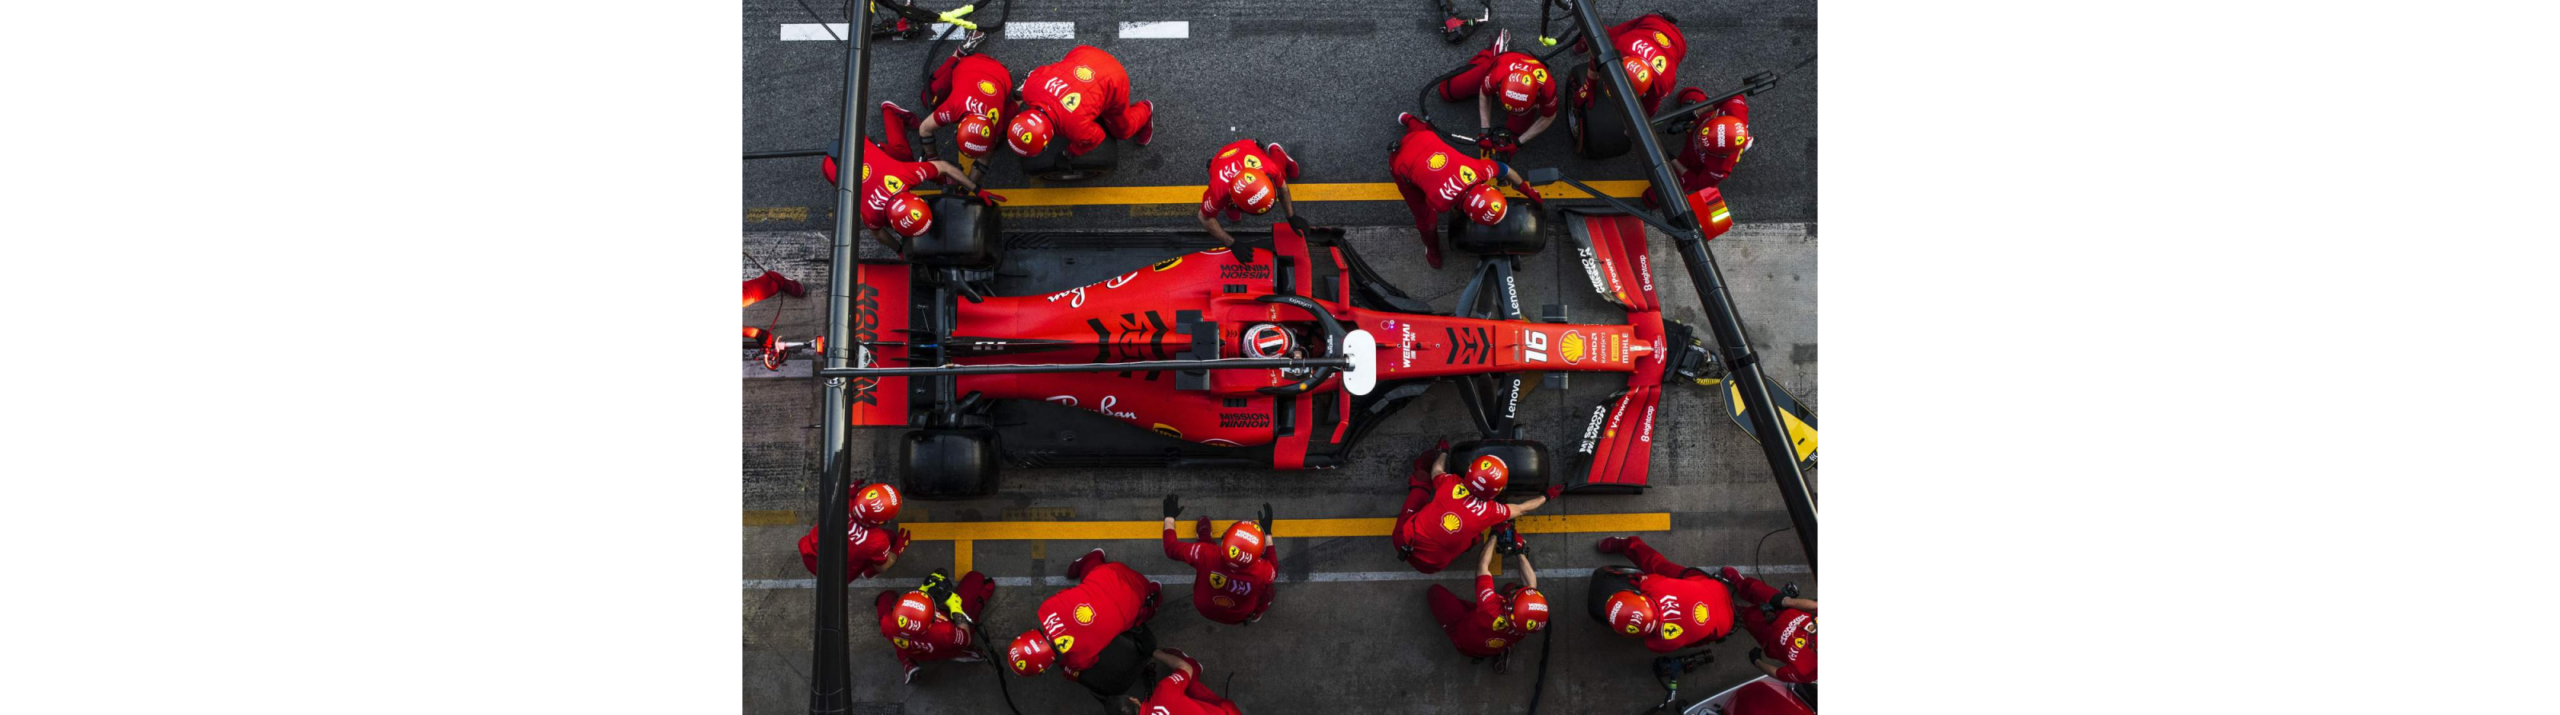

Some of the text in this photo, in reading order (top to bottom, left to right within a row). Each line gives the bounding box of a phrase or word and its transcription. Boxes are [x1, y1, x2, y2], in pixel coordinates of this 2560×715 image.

[1605, 257, 1621, 291] V-Power
[1640, 255, 1650, 284] eightcap
[1506, 276, 1520, 316] Lenovo
[1402, 323, 1411, 368] WEICHAI
[1524, 328, 1548, 363] 16
[1505, 379, 1521, 419] Lenovo
[1611, 396, 1630, 429] V-Power
[1644, 405, 1655, 435] eightcap
